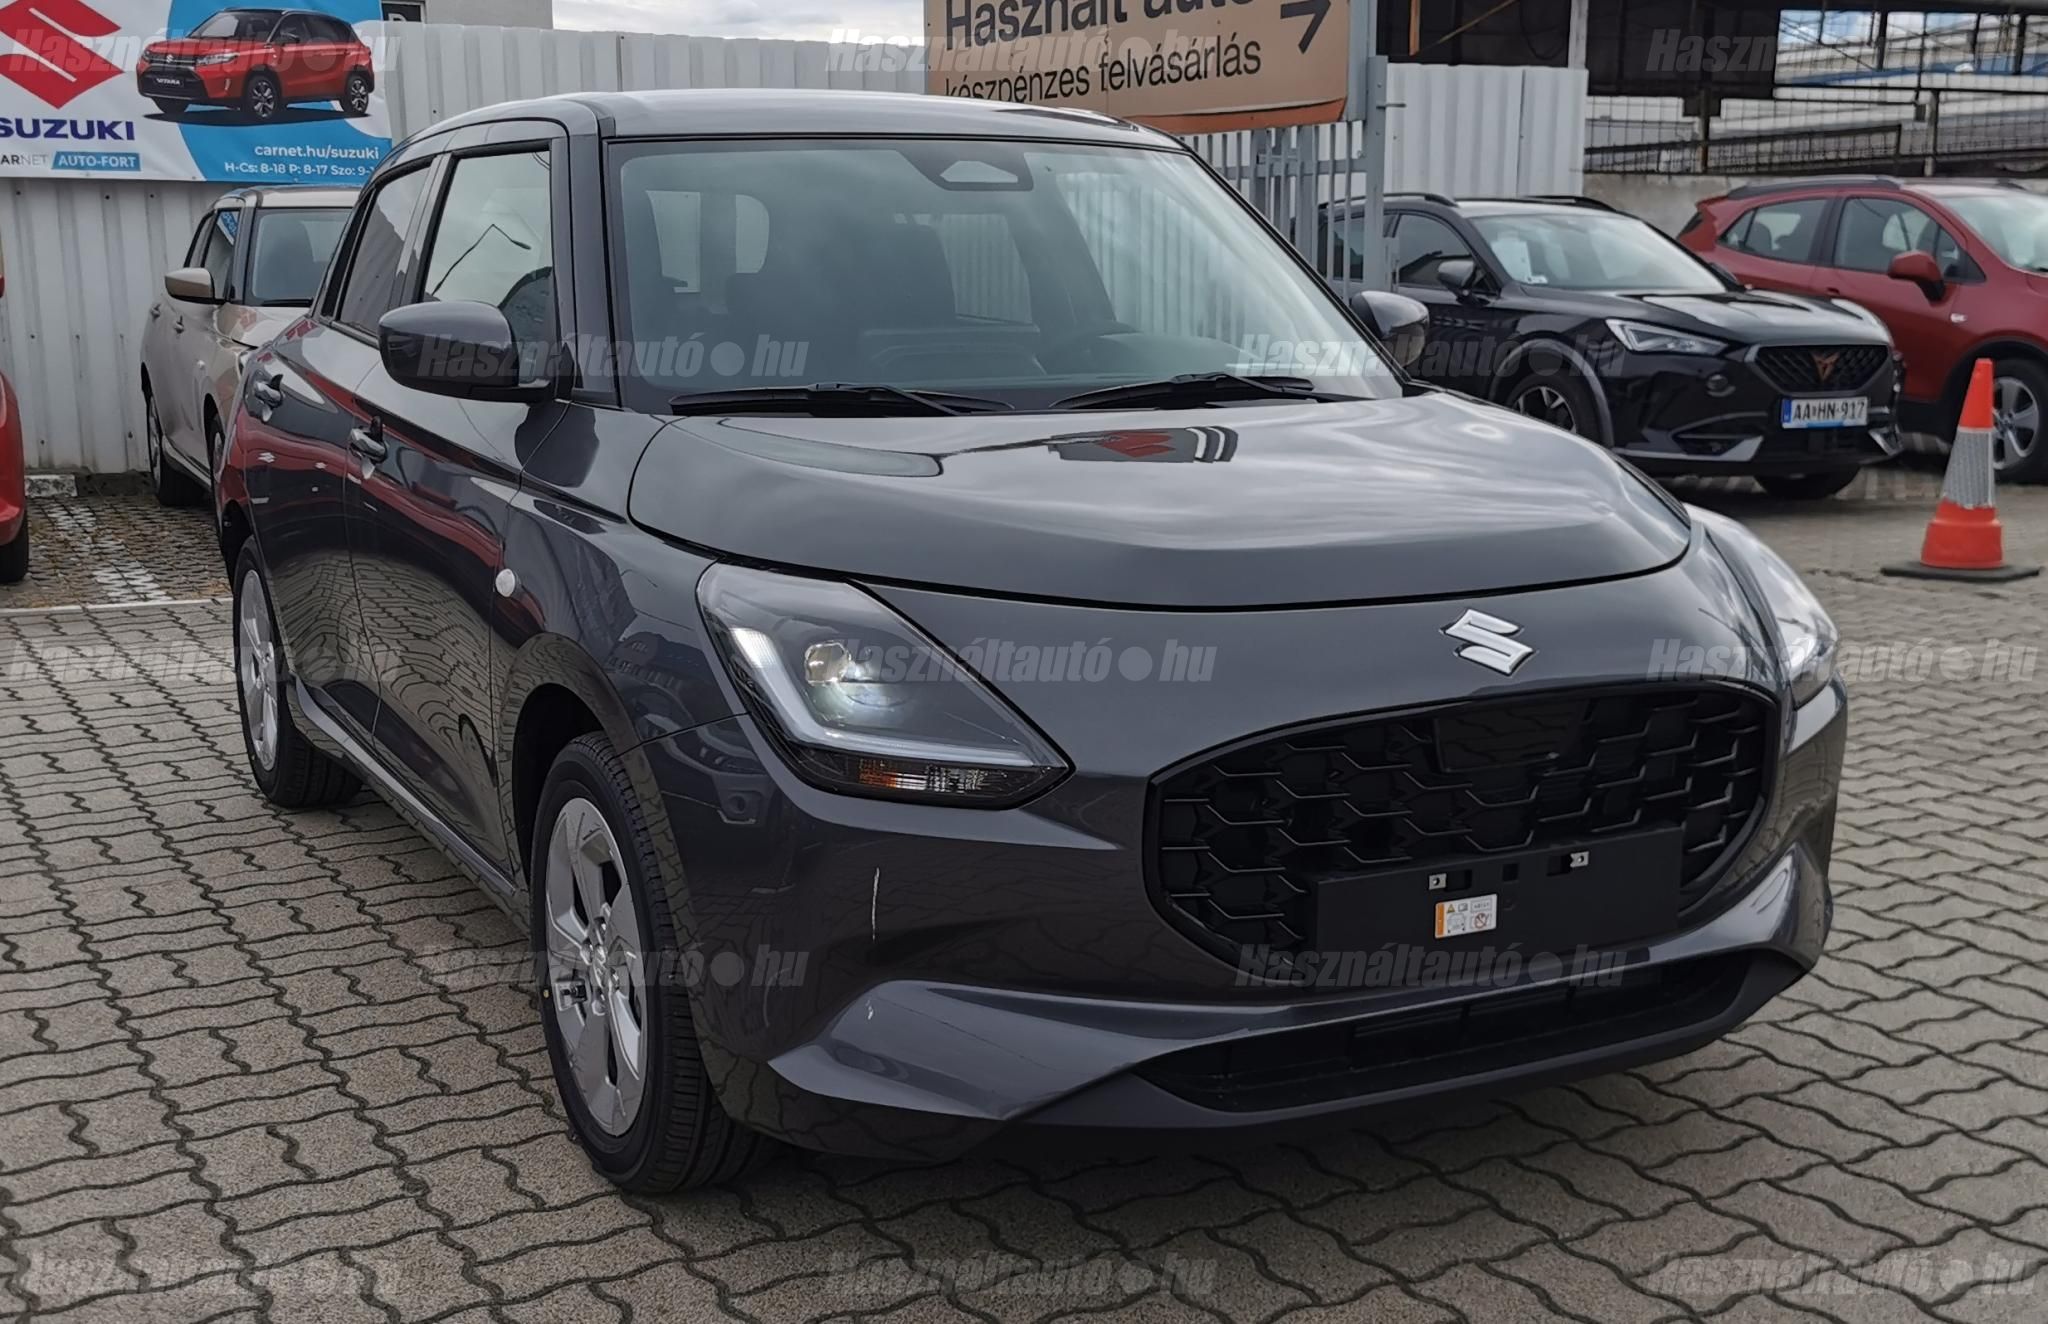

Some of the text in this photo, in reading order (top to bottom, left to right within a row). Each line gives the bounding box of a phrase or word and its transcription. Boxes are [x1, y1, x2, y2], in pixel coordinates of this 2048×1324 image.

[1098, 32, 1262, 92] felvásárlás
[0, 116, 135, 140] SUZUKI
[254, 144, 380, 159] carnet.hu/suzuki
[58, 155, 137, 168] AUTO-FORT
[224, 162, 258, 173] H-Cs:
[260, 163, 286, 174] 8-18
[289, 163, 301, 174] P:
[303, 164, 328, 175] 8-17
[331, 164, 356, 176] Szo:
